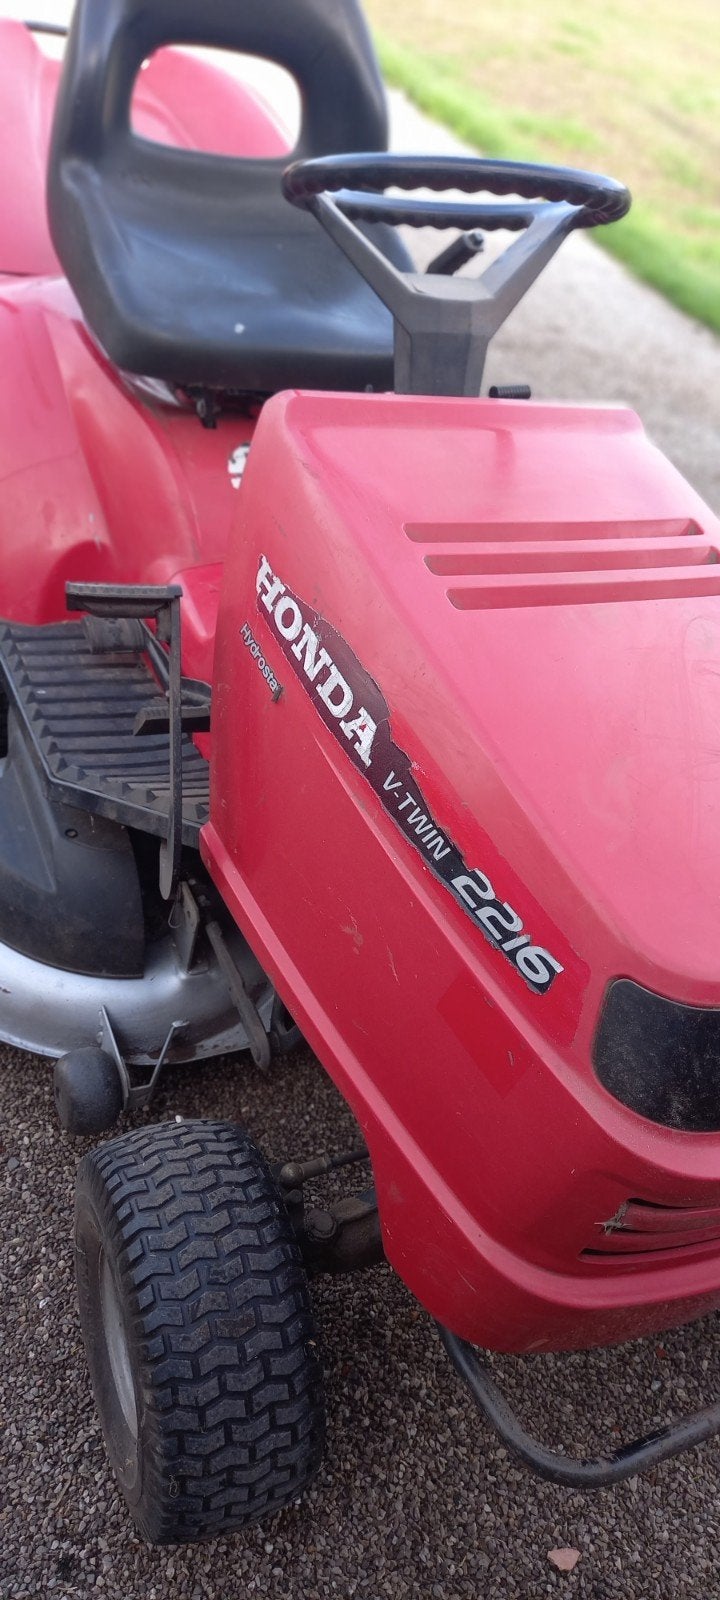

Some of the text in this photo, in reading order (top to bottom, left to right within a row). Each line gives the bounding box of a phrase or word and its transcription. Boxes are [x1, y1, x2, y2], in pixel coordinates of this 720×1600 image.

[240, 622, 282, 700] Hydrosta
[256, 556, 564, 983] HONDA V-TWIN 2216
